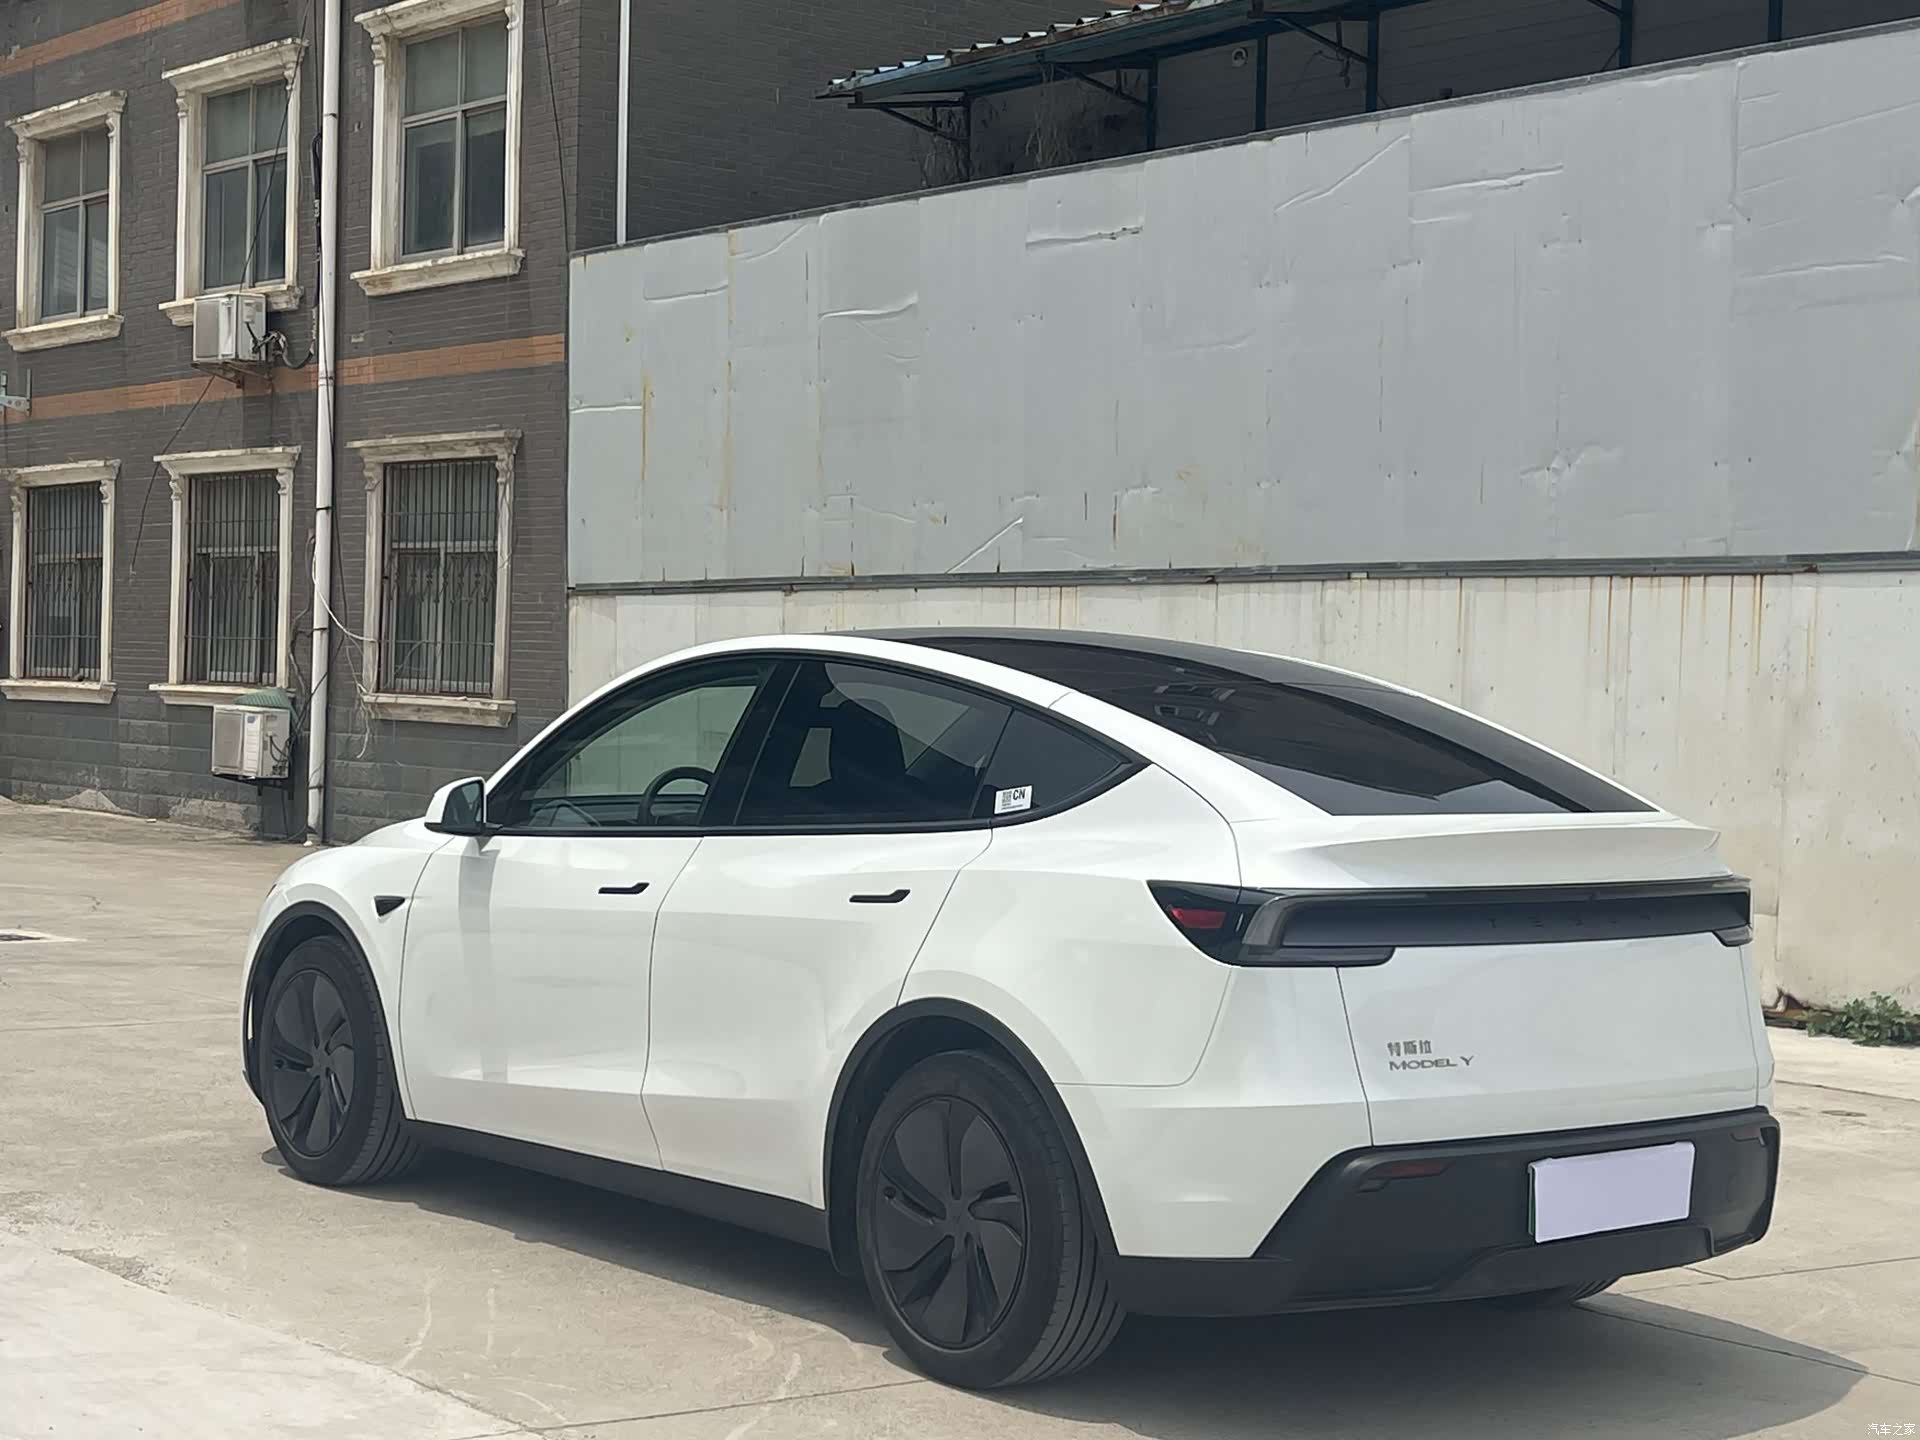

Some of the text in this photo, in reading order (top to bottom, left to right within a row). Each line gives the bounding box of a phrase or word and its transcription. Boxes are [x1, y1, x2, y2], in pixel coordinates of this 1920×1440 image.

[1013, 788, 1026, 801] CN
[1389, 1055, 1473, 1071] MODEL Y
